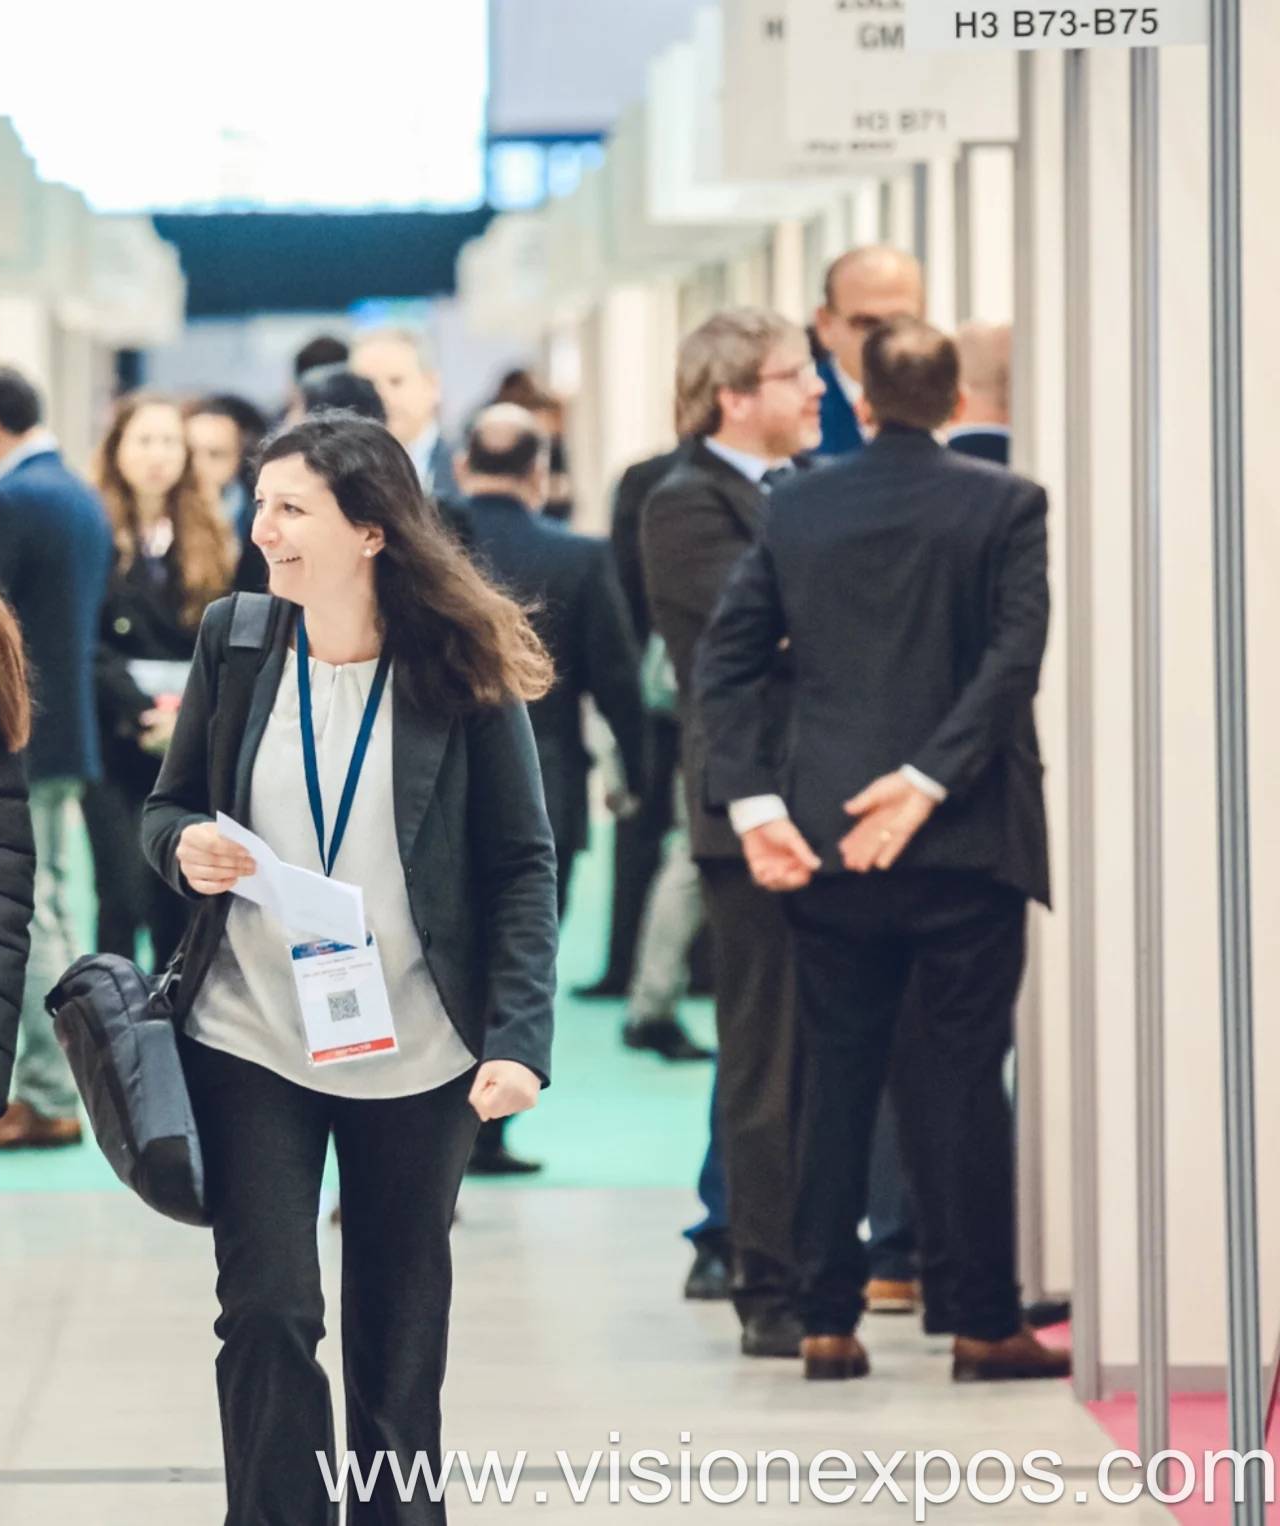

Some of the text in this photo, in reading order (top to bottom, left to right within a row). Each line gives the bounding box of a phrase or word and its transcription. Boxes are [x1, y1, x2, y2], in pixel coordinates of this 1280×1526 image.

[955, 8, 1158, 38] H3 B73-B75
[854, 109, 947, 132] H3 B71
